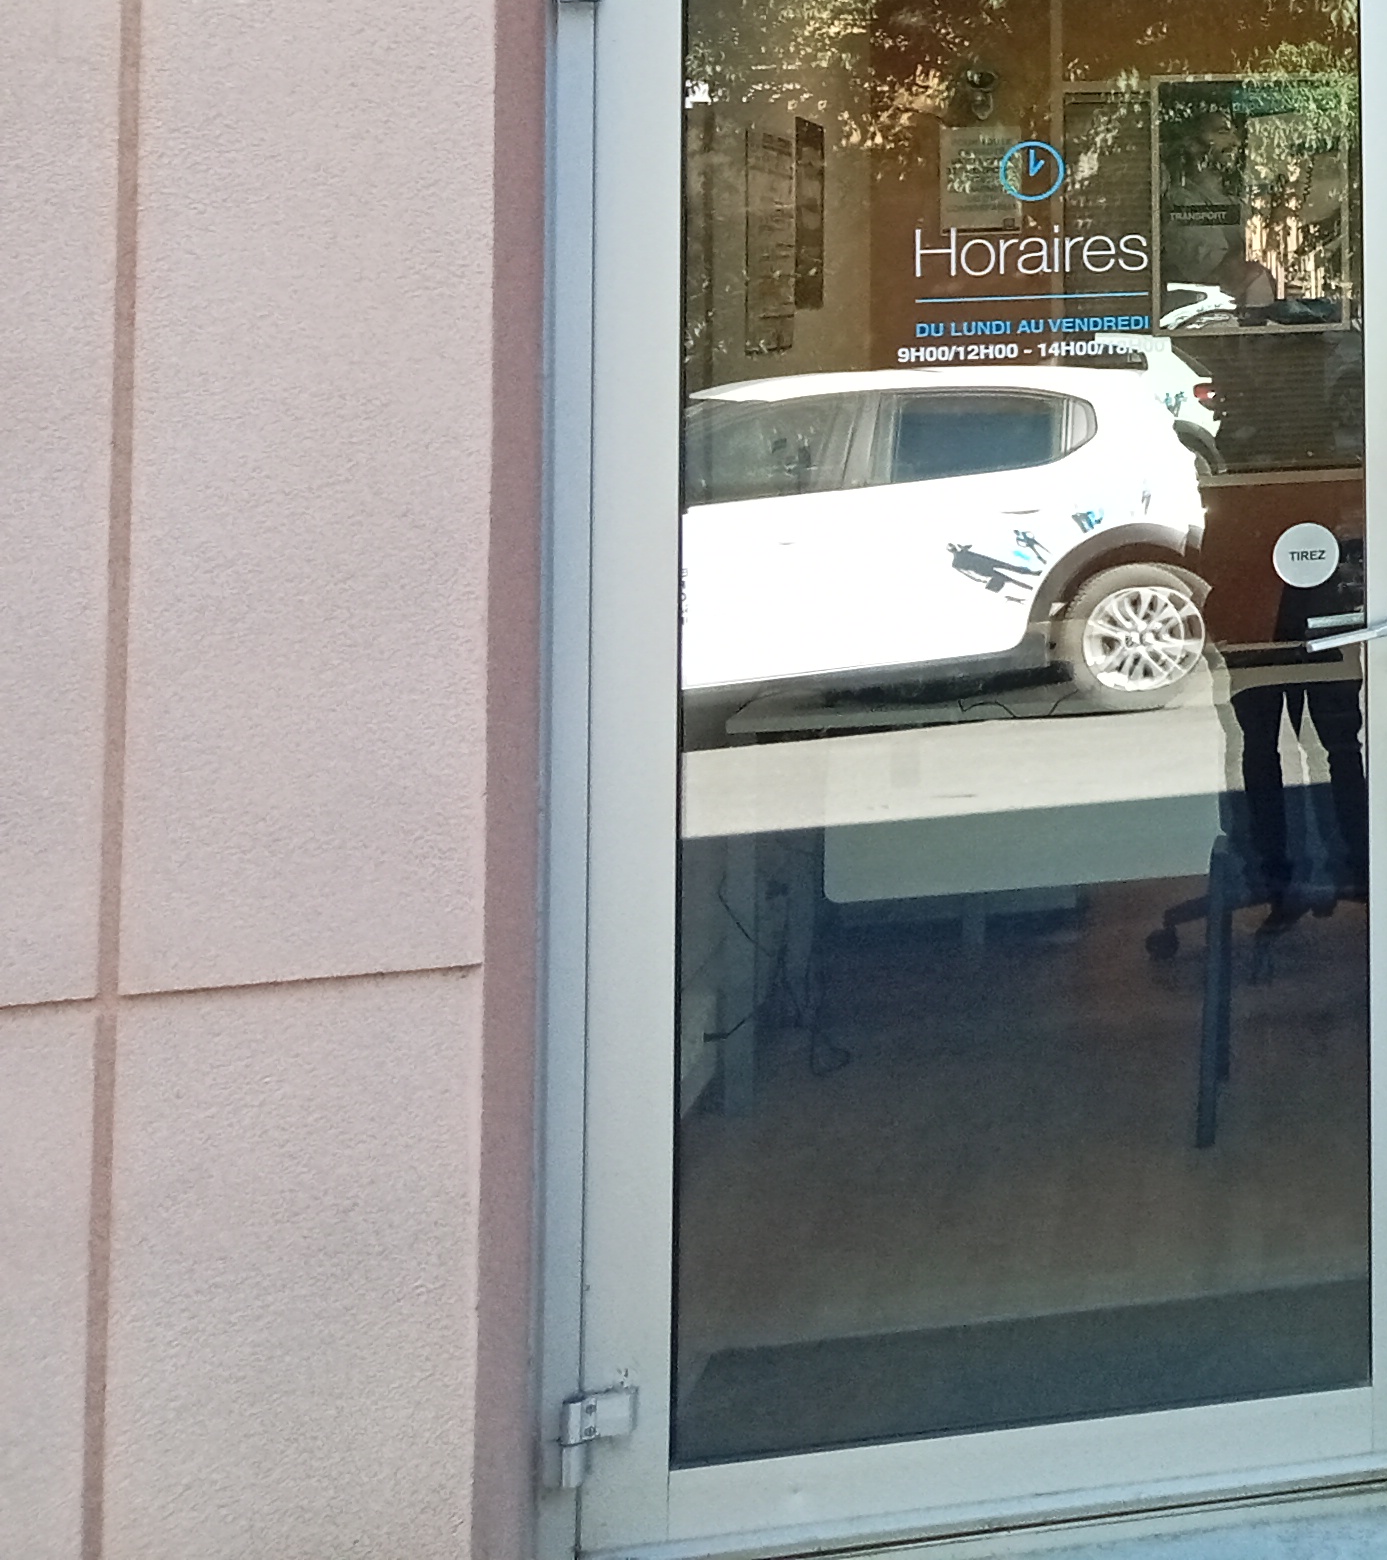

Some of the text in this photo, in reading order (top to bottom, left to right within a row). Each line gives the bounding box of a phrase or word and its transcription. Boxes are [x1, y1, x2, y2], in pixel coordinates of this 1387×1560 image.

[914, 225, 1149, 278] Horaires
[915, 315, 1150, 338] DU LUNDI AU VENDREDI
[897, 343, 1019, 363] 9H00/12H00
[1288, 549, 1327, 562] TIREZ
